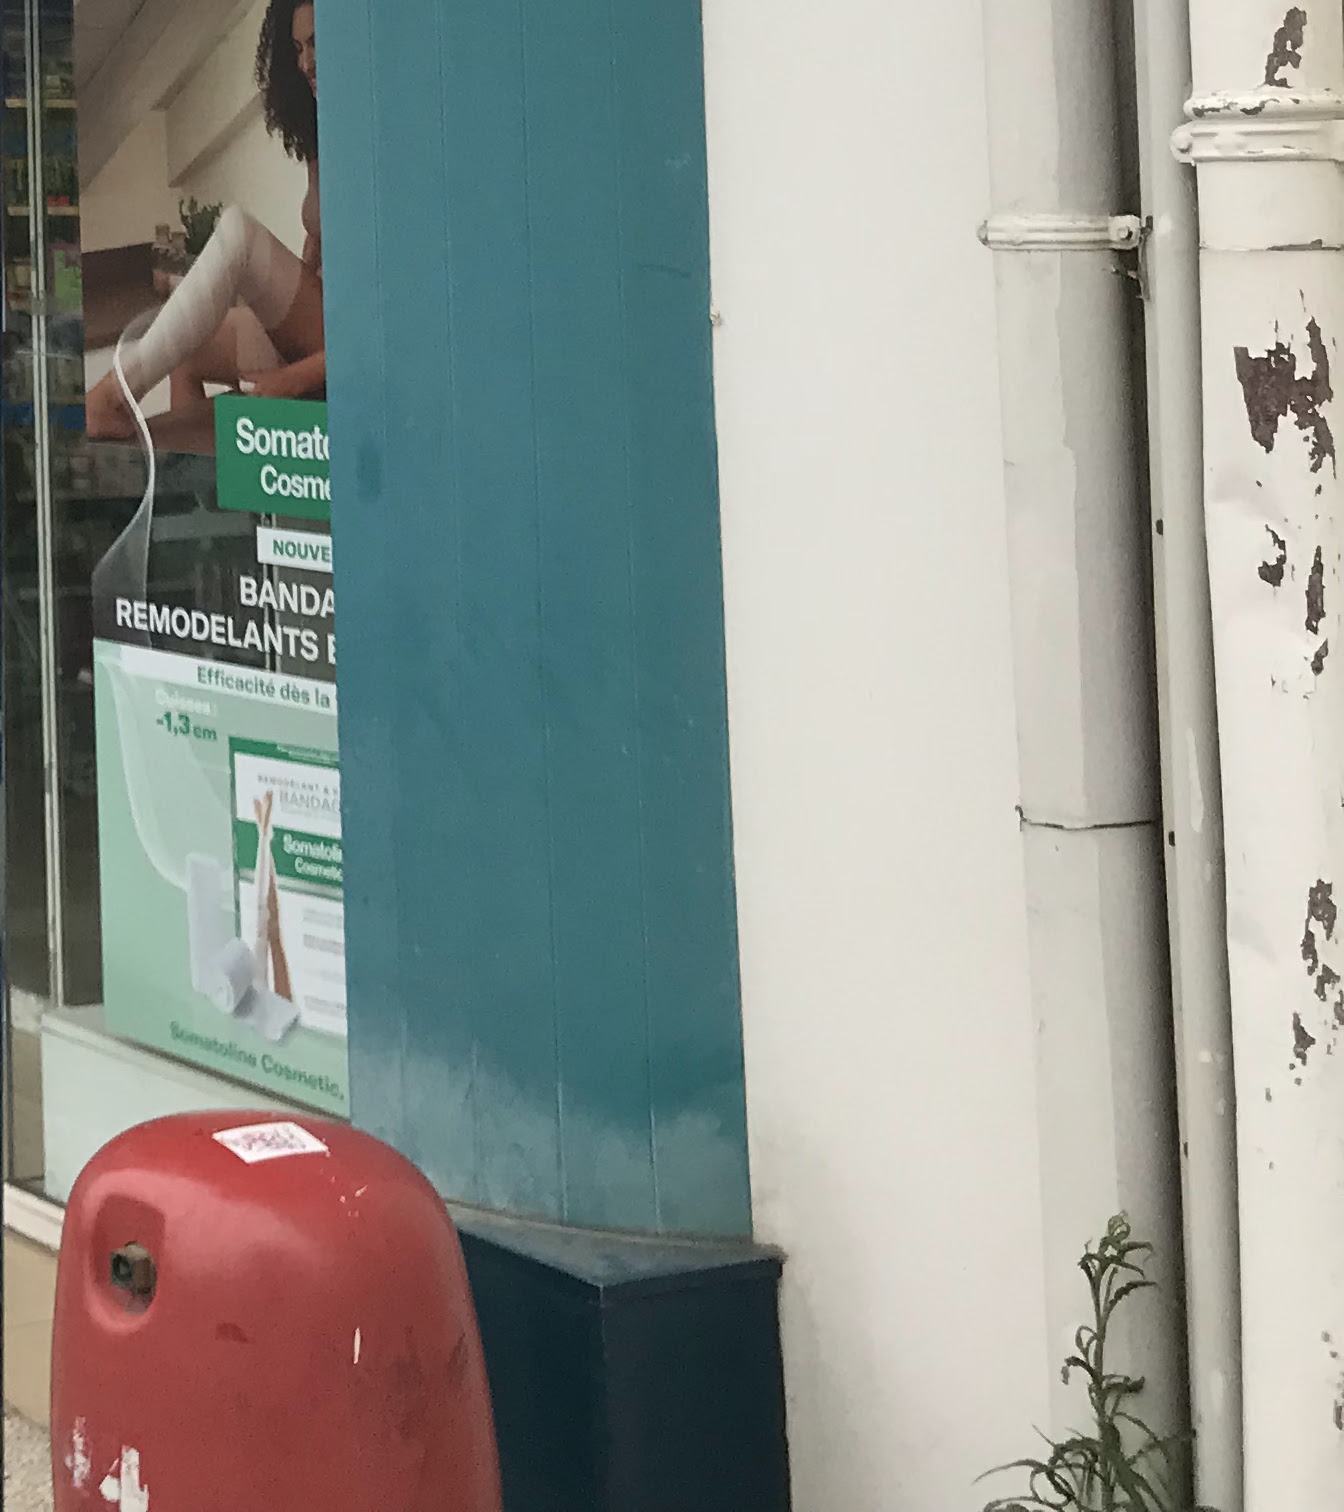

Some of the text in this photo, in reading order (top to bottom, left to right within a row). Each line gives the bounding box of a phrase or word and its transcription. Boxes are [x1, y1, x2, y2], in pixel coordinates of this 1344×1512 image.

[115, 597, 320, 662] REMODELANTS
[197, 665, 331, 709] Efficacité dès la
[192, 726, 217, 741] cm
[169, 1020, 257, 1067] Somatoline
